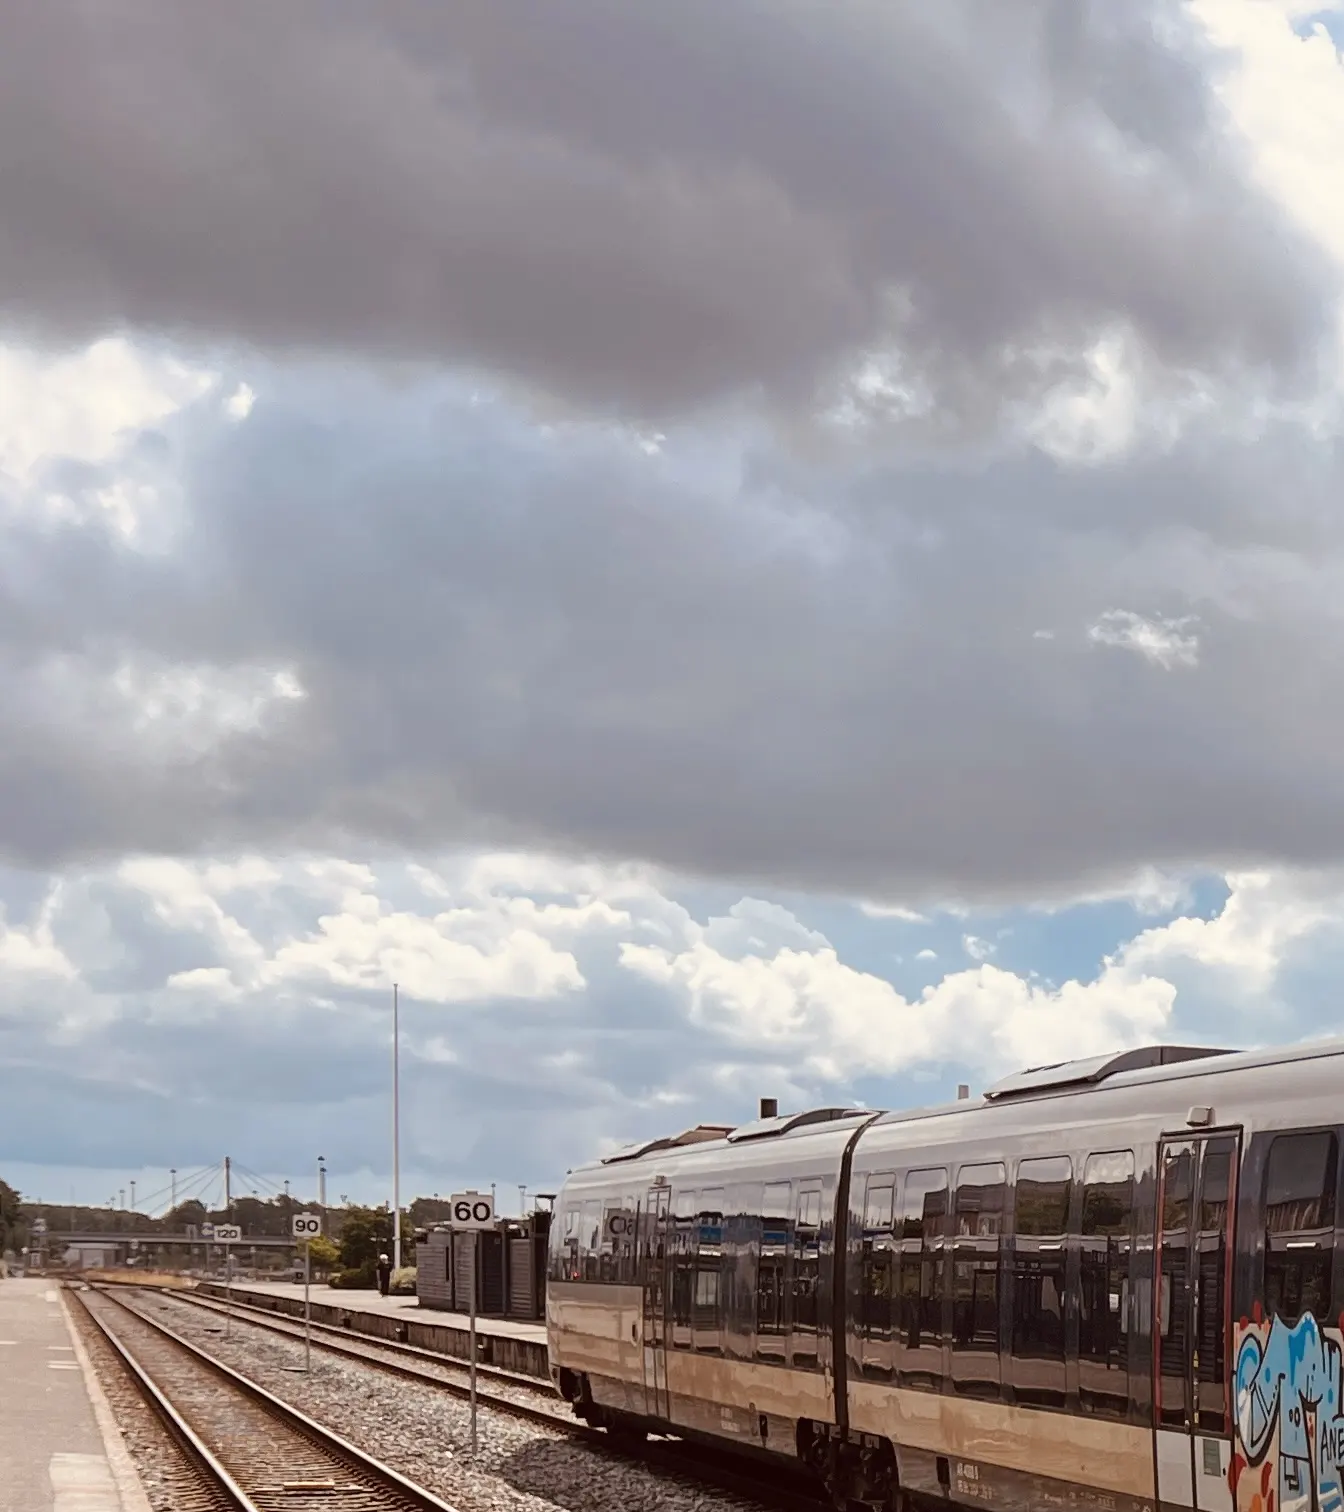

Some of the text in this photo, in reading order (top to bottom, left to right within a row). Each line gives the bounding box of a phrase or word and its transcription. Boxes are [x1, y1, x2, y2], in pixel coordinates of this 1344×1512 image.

[454, 1201, 491, 1222] 60
[295, 1219, 319, 1233] 90
[217, 1228, 238, 1239] 120
